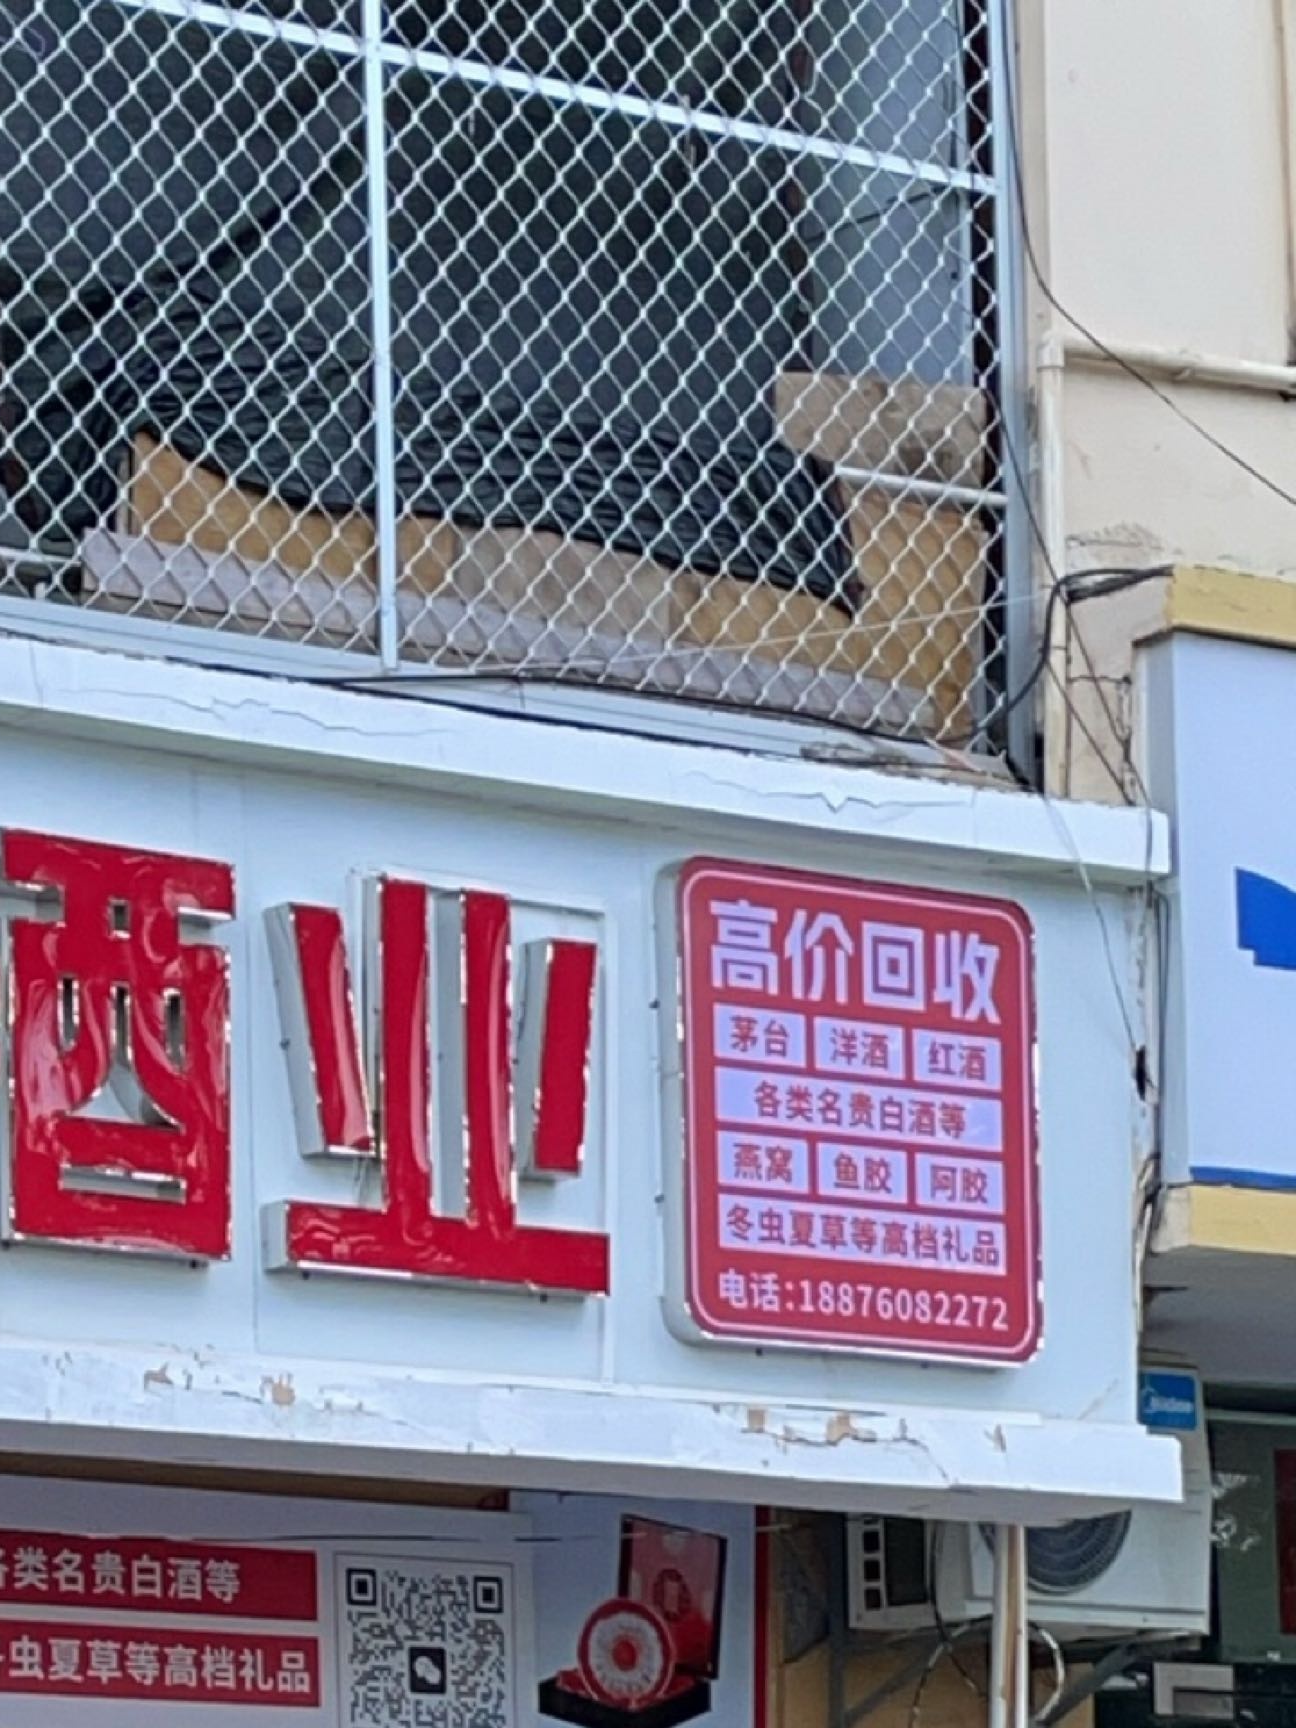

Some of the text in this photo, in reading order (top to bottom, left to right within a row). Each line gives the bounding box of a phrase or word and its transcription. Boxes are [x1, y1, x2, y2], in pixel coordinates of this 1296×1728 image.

[710, 899, 1001, 1024] 高价回收
[729, 1015, 987, 1082] 茅台 洋酒 红酒
[753, 1080, 967, 1139] 各类名贵白酒等
[733, 1142, 989, 1206] 燕窝 鱼胶 阿胶
[725, 1205, 1000, 1268] 冬虫夏草等高档礼品
[717, 1270, 1010, 1332] 电话:18876082272
